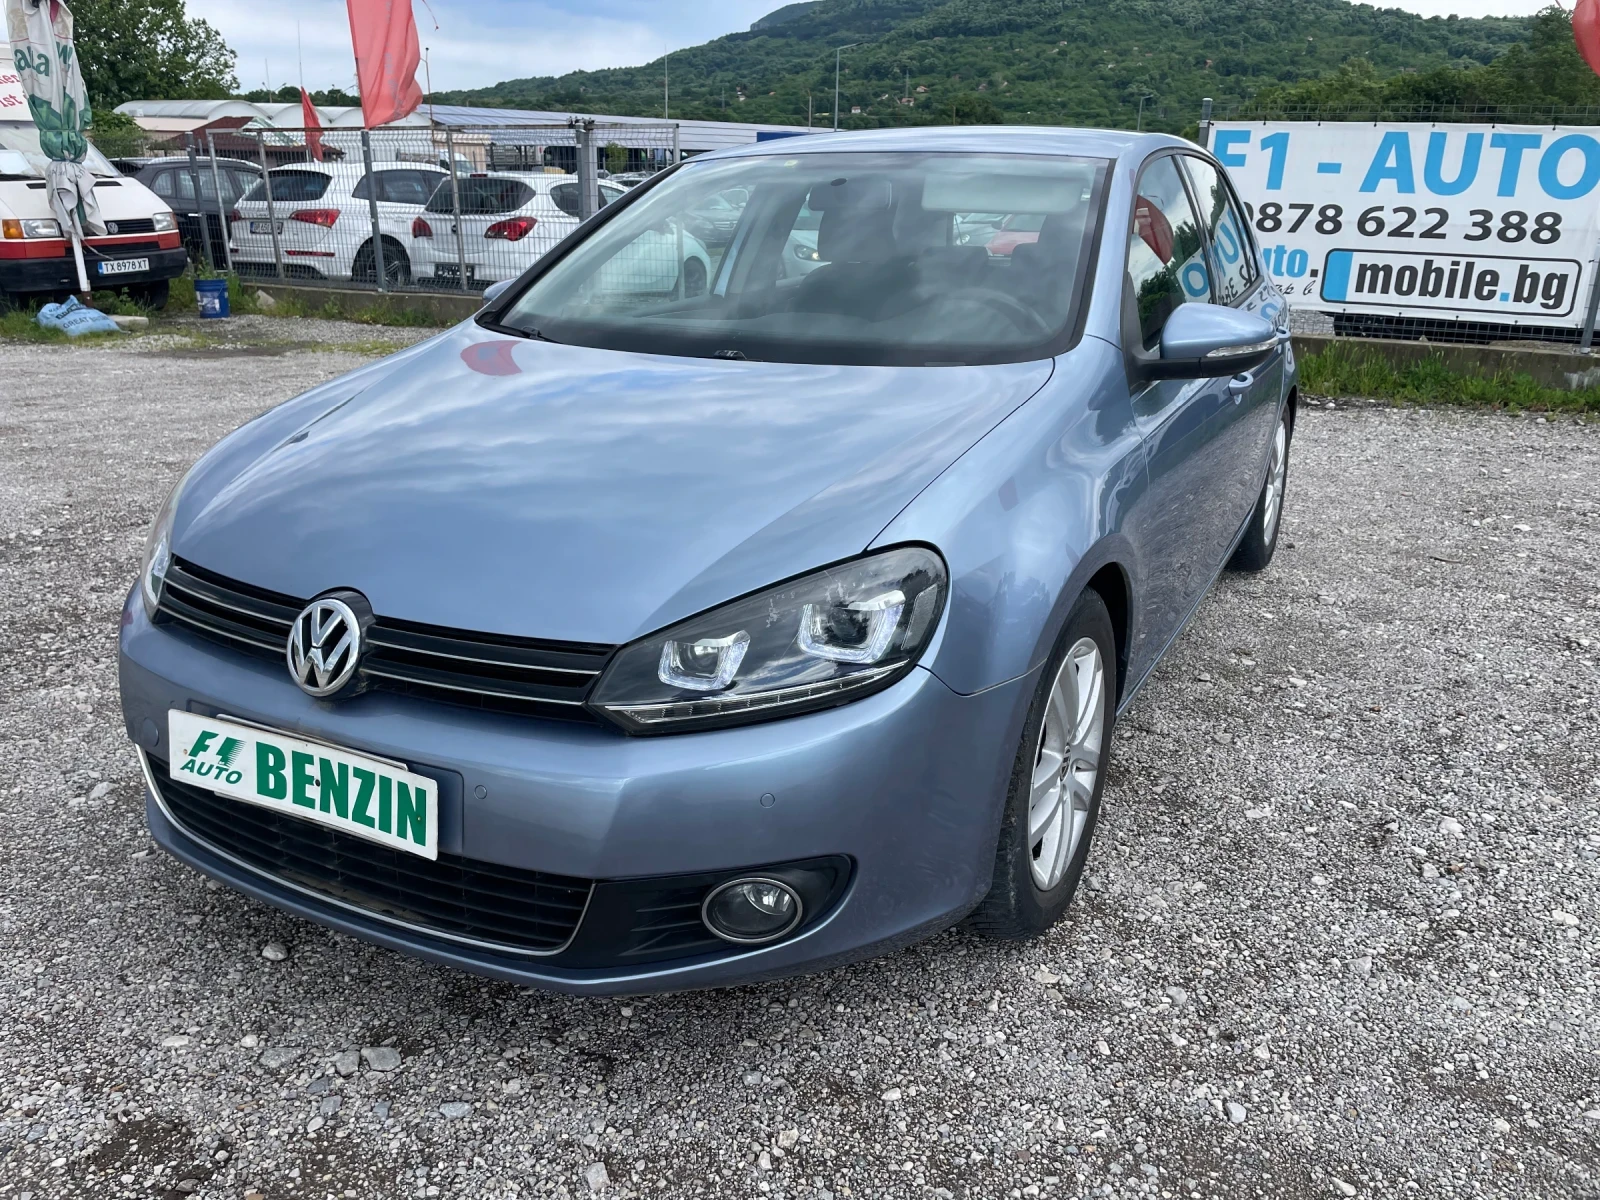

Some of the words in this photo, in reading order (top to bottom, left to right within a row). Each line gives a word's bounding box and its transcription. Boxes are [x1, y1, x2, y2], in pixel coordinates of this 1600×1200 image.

[1212, 130, 1290, 190] F1
[1358, 132, 1600, 200] AUTO
[1357, 205, 1449, 239] 622
[1463, 209, 1562, 244] 388
[1355, 259, 1569, 310] mobile.bg
[63, 316, 89, 329] GREAT
[180, 758, 243, 785] AUTO
[256, 741, 427, 847] BENZIN
